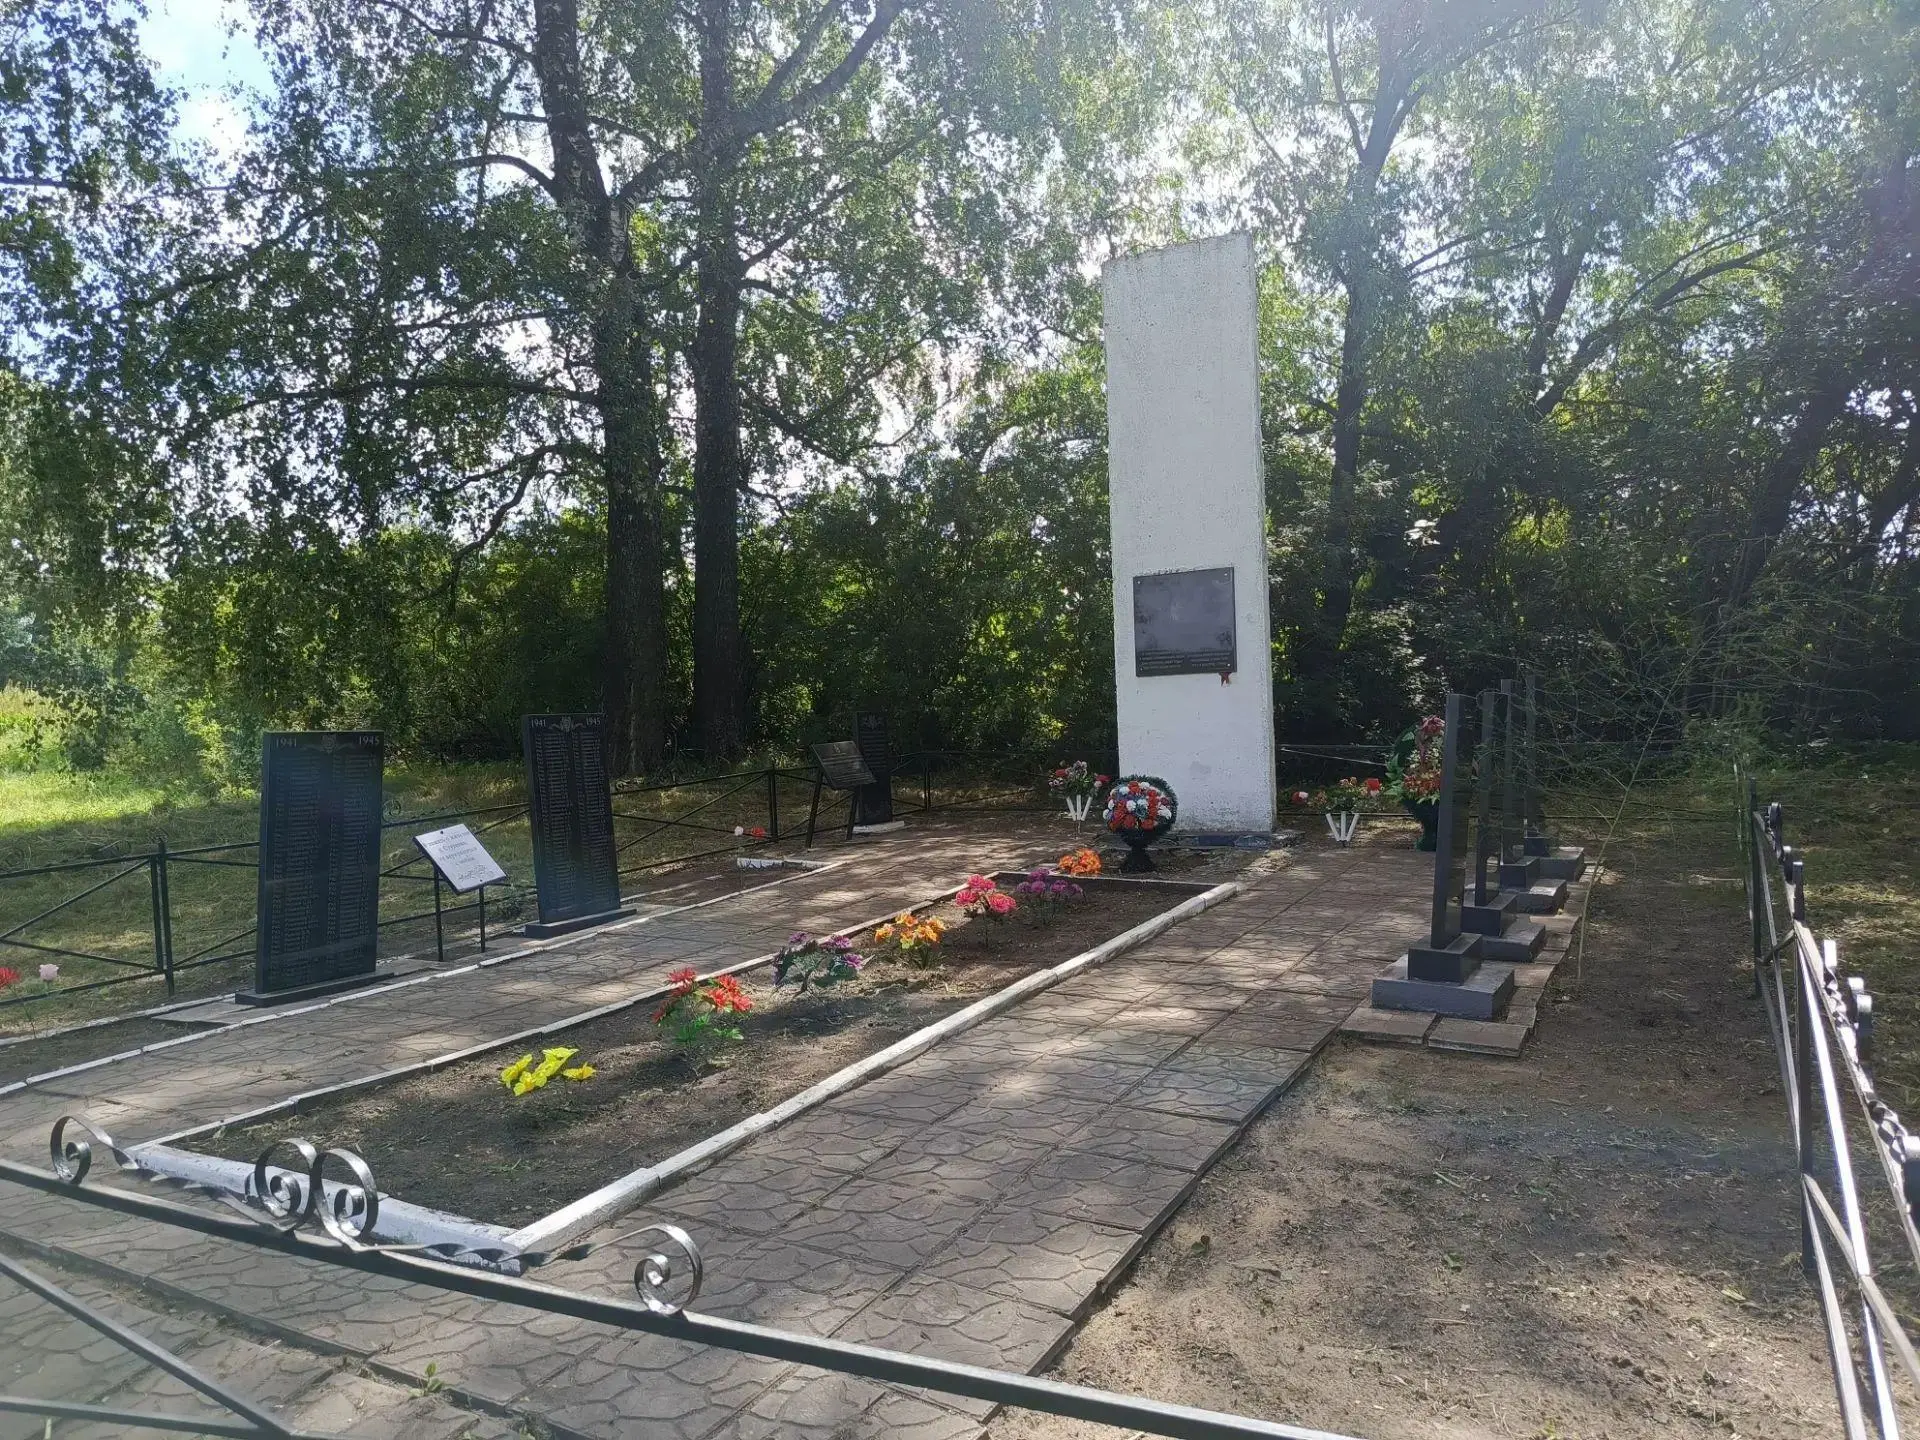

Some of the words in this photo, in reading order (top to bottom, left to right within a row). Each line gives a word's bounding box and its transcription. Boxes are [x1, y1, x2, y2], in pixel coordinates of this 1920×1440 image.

[531, 719, 547, 728] 1941
[585, 716, 601, 726] 1945
[275, 736, 297, 748] 1941
[359, 734, 379, 746] 1945
